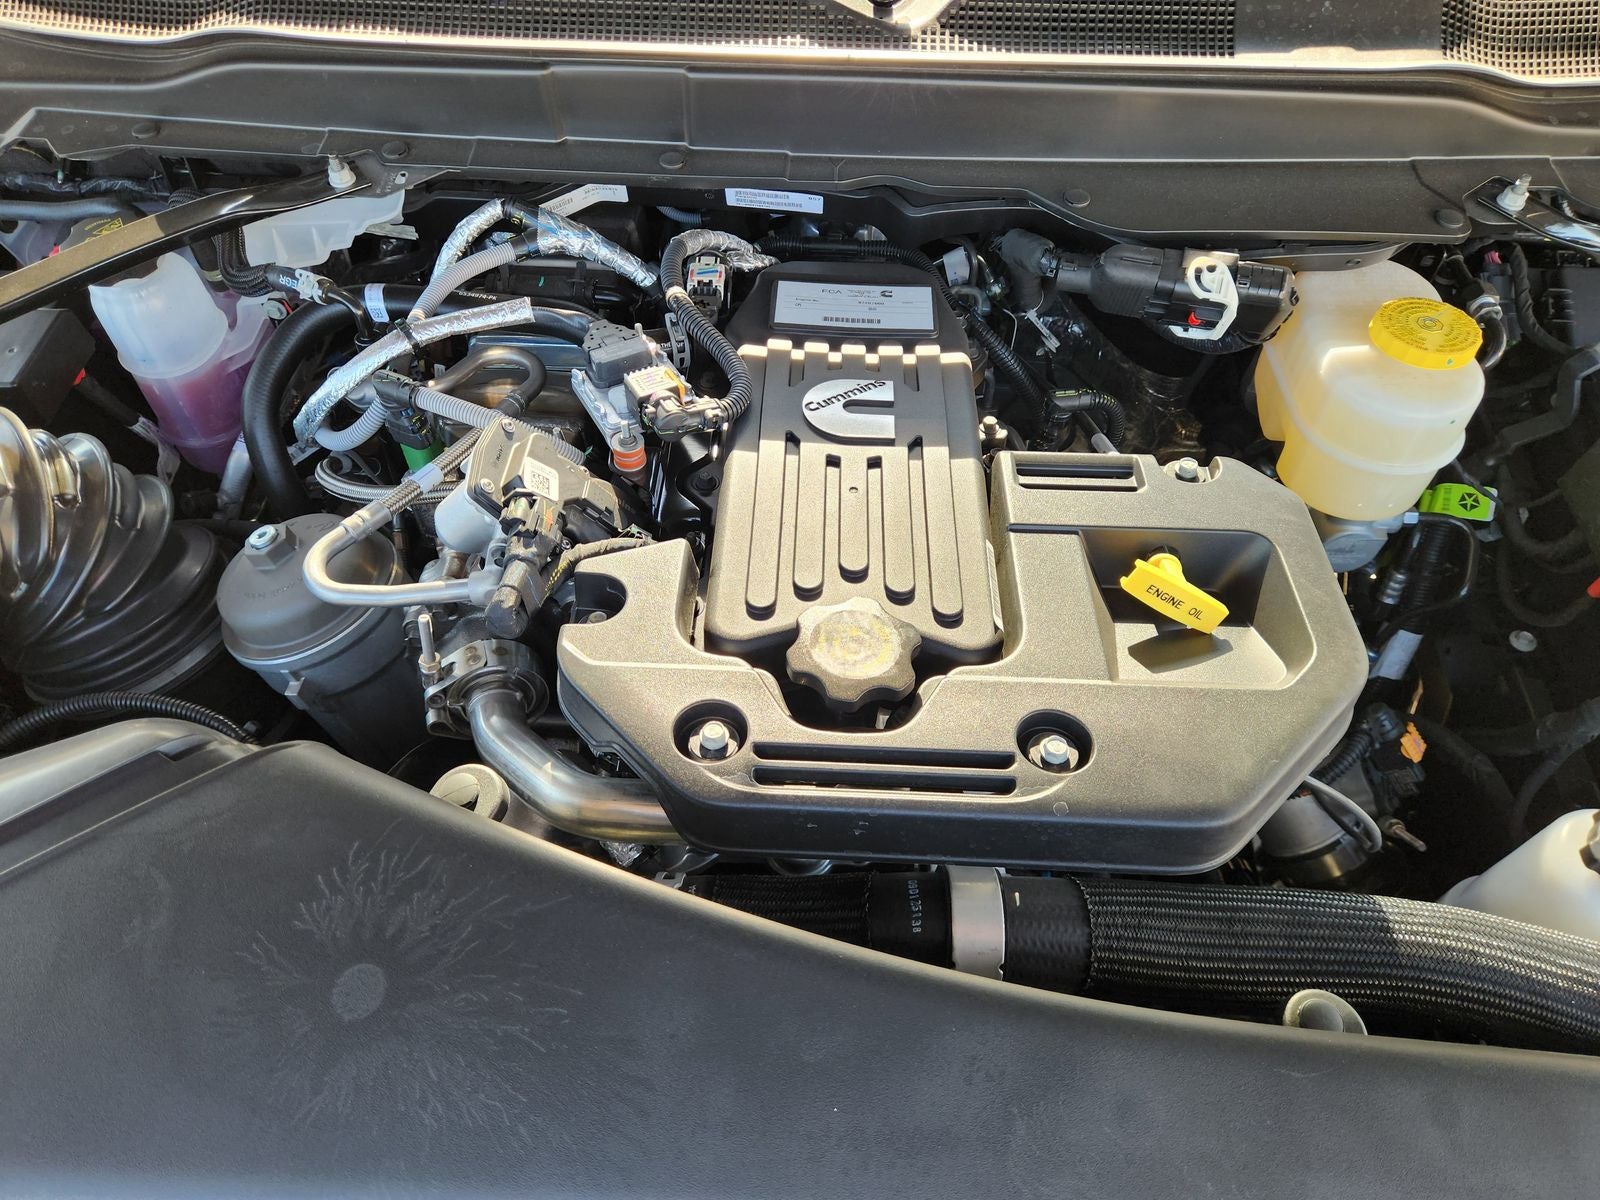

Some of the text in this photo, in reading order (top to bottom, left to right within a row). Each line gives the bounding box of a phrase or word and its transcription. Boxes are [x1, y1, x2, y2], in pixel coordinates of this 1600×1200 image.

[279, 274, 298, 289] EGR
[804, 379, 886, 412] Cummins
[1146, 584, 1204, 621] ENGINE OIL
